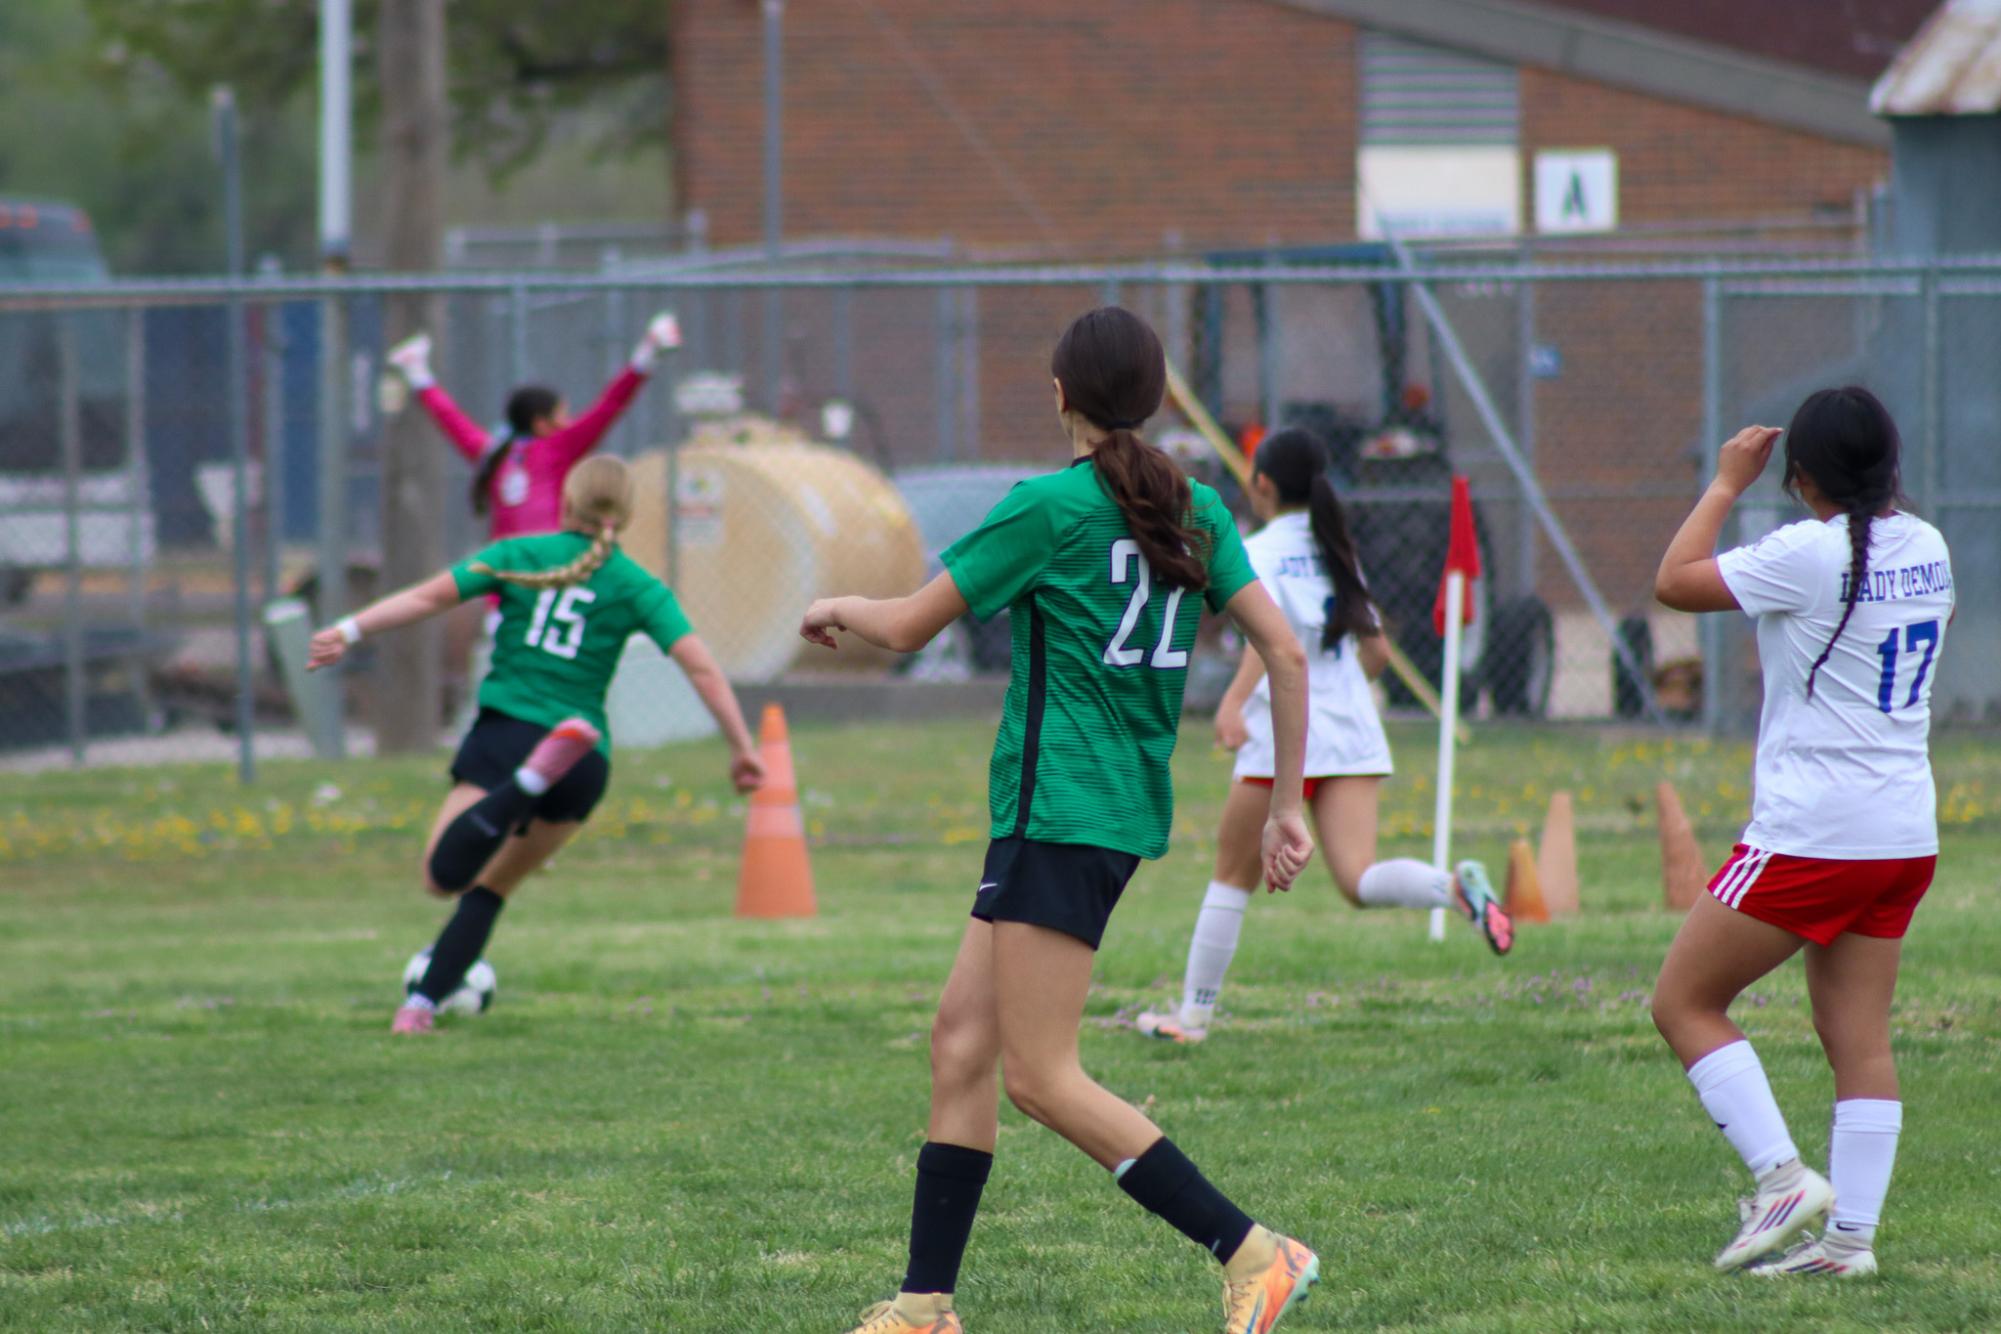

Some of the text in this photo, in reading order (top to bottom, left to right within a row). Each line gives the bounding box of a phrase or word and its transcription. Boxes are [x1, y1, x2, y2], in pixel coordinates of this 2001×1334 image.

[1562, 168, 1588, 219] A
[524, 586, 597, 658] 15
[1877, 620, 1939, 713] 17
